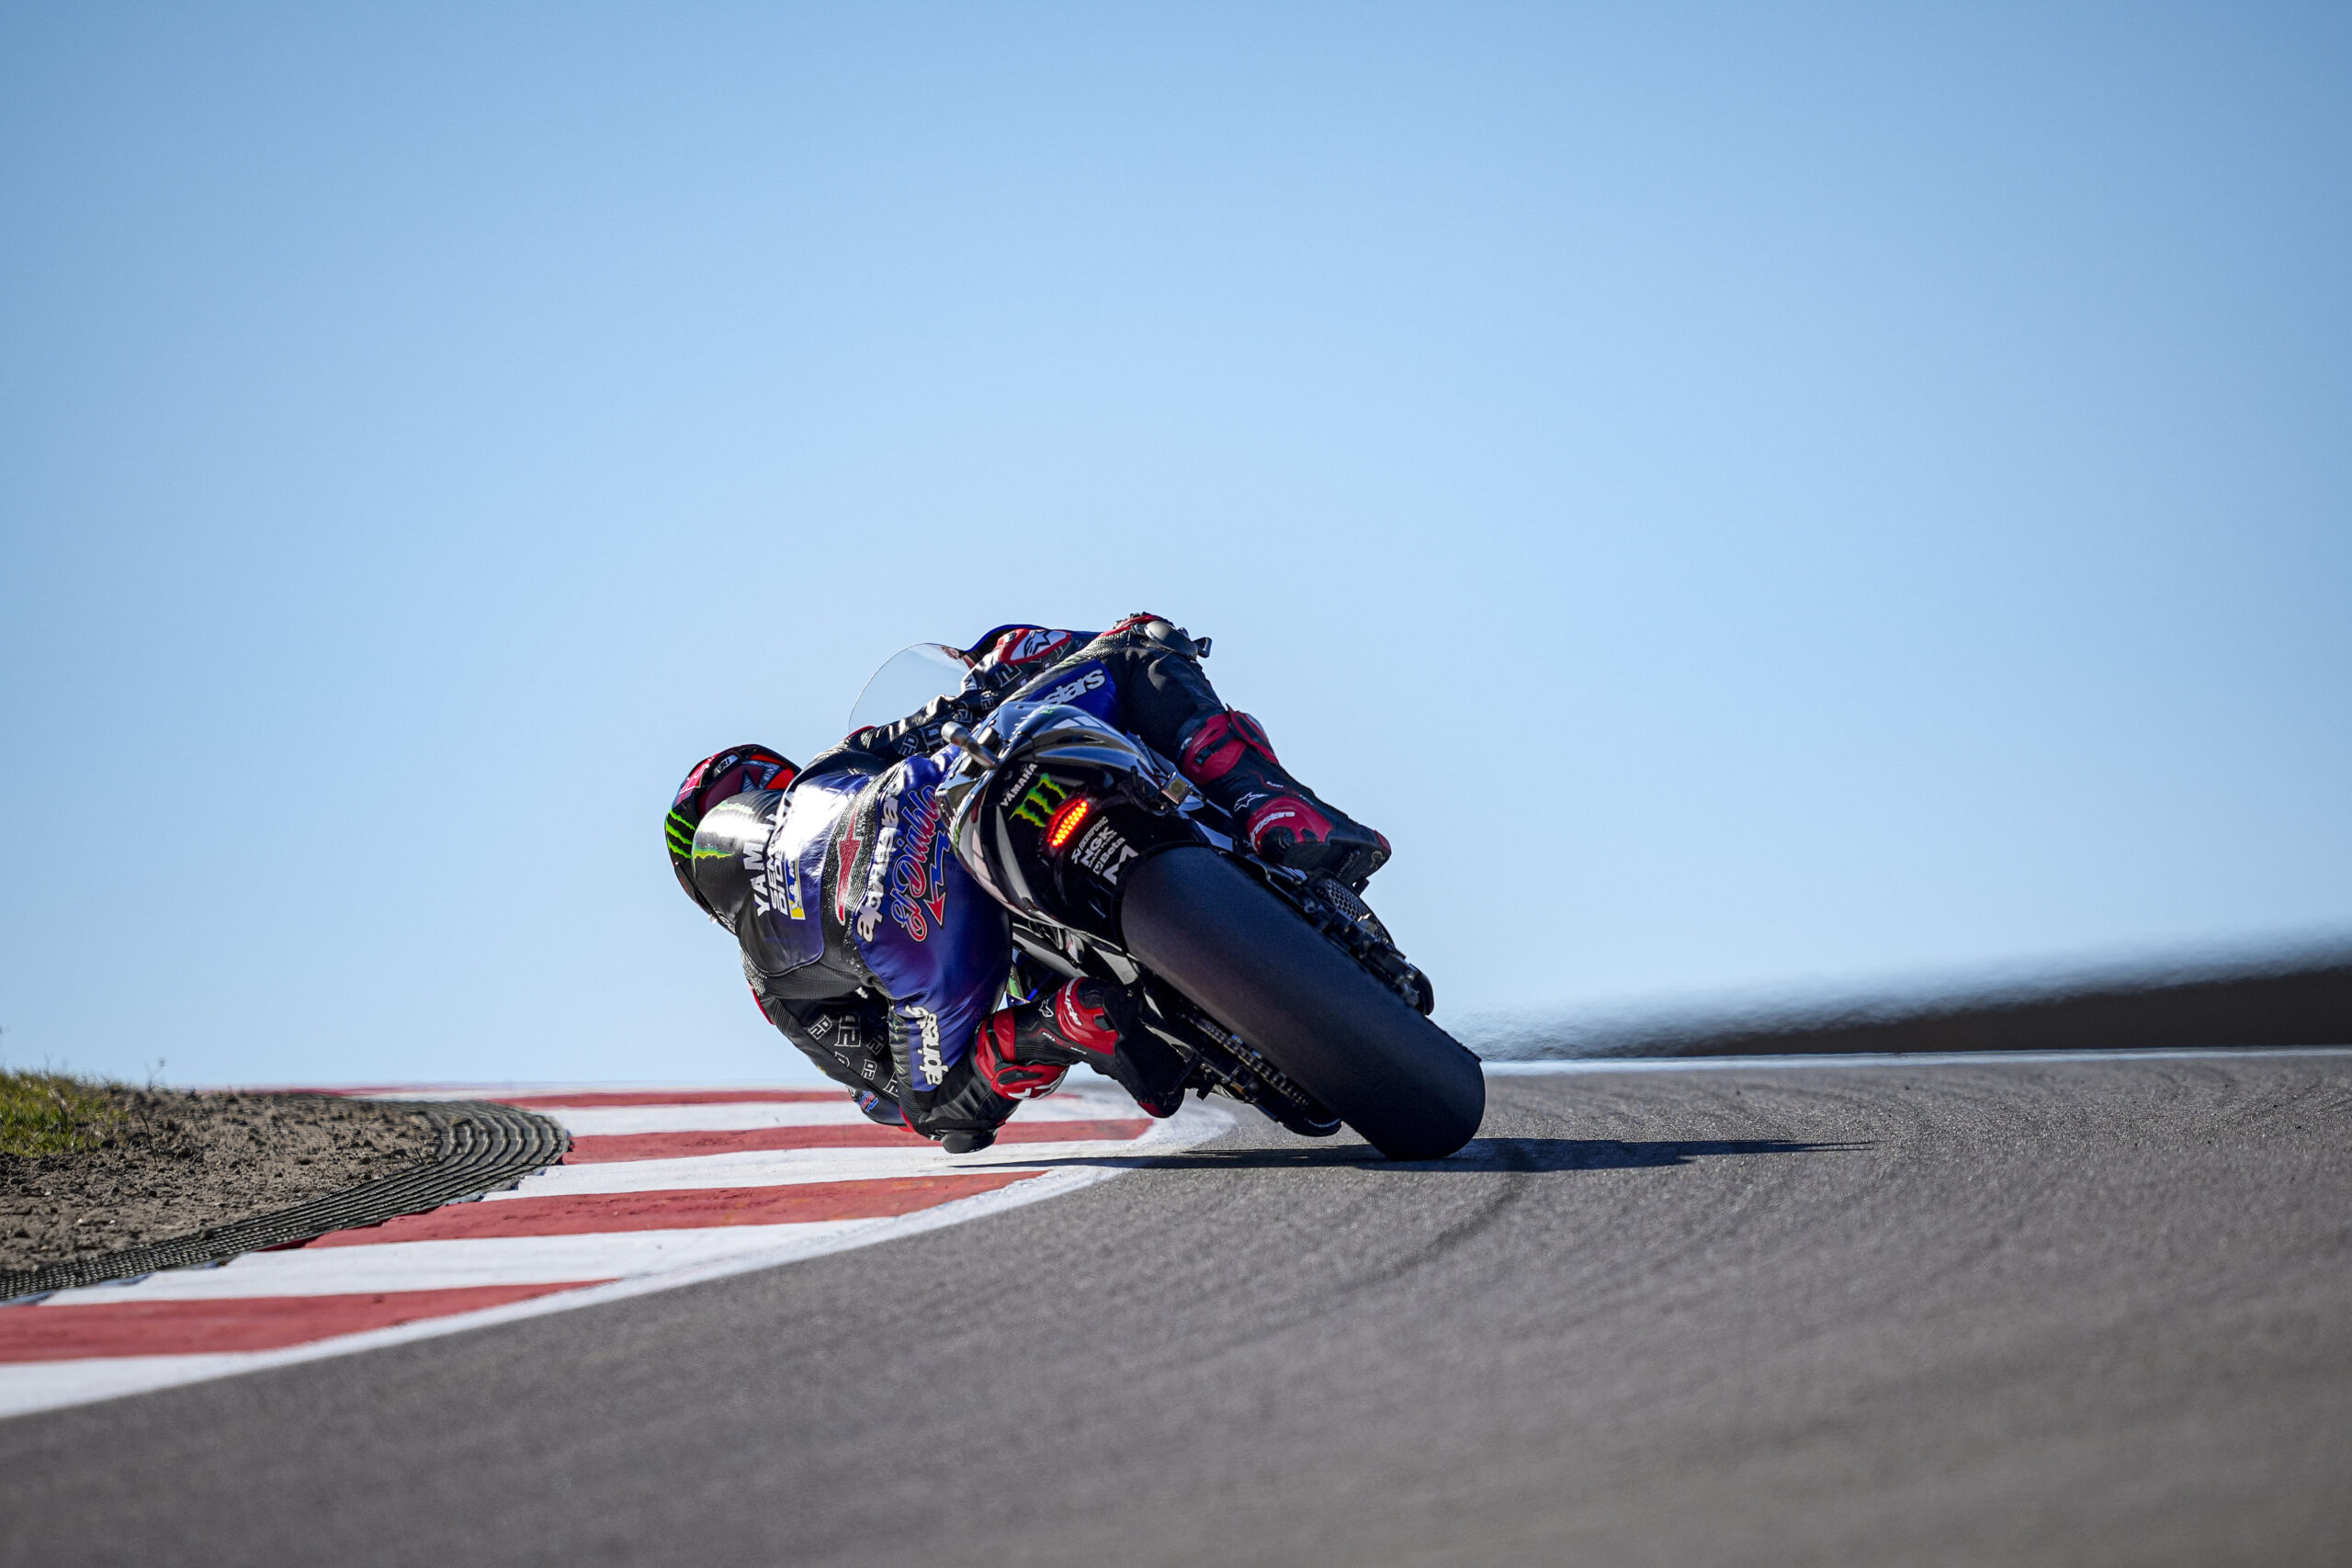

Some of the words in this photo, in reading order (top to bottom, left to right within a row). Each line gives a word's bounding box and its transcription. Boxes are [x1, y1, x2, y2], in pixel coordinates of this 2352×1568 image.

[1041, 669, 1105, 705] stars
[1000, 762, 1038, 807] YAMAHA
[1080, 826, 1114, 866] NGK
[1099, 837, 1126, 863] Beta
[890, 889, 927, 942] El
